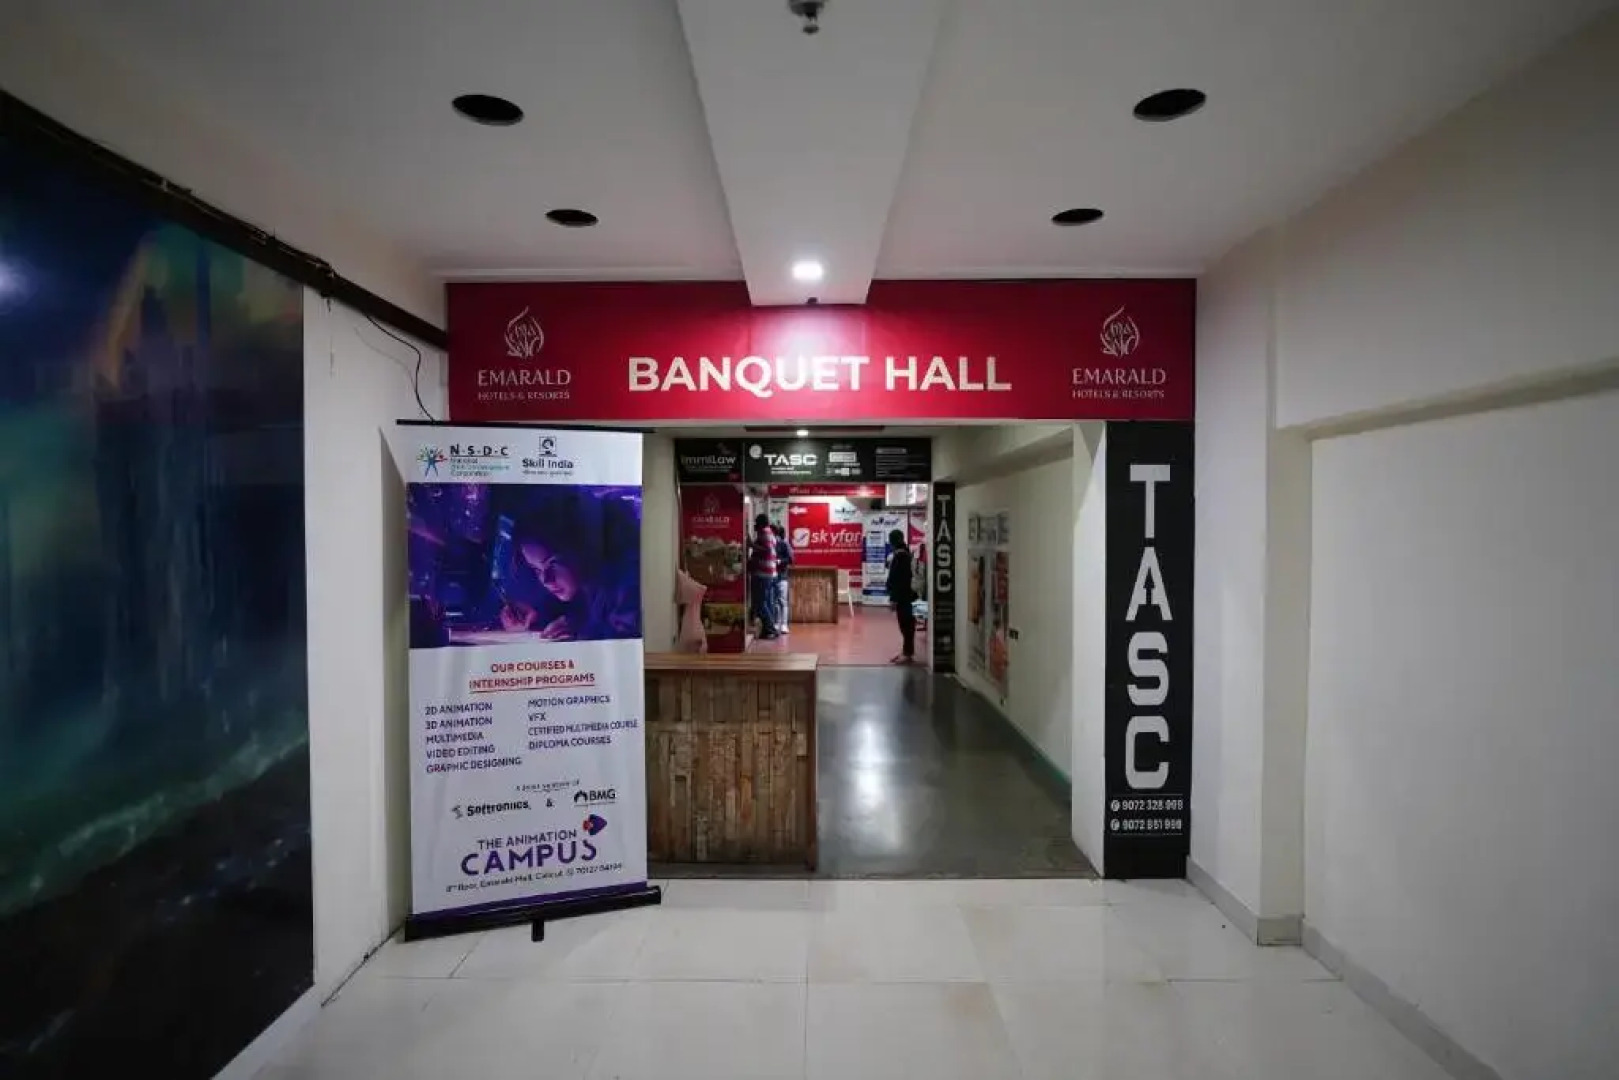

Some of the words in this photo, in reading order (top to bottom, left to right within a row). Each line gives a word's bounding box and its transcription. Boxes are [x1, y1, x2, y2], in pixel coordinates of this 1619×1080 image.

[477, 369, 571, 387] EMARALD
[629, 356, 869, 397] BANQUET
[885, 356, 1012, 391] HALL
[1072, 368, 1166, 385] EMARALD
[478, 391, 514, 401] HOTELS
[527, 390, 570, 400] RESORTS
[1072, 389, 1110, 399] HOTELS
[1121, 389, 1165, 399] RESORTS
[522, 458, 545, 468] Skill
[547, 459, 574, 469] India
[764, 454, 817, 466] TASC
[936, 494, 952, 592] TASC
[1125, 464, 1173, 789] TASC
[490, 663, 515, 673] OUR
[516, 660, 567, 671] COURSES
[469, 676, 534, 688] INTERNSHIP
[535, 673, 595, 684] PROGRAMS
[528, 698, 564, 707] MOTION
[565, 695, 610, 705] GRAPHICS
[425, 706, 438, 715] 2D
[439, 702, 493, 714] ANIMATION
[425, 721, 437, 730] 3D
[439, 717, 493, 728] ANIMATION
[528, 712, 546, 722] VFX
[528, 725, 565, 736] CERTIFIED
[566, 722, 609, 733] MULTIMEDIA
[610, 718, 638, 729] COURSE
[426, 732, 484, 744] MULTIMEDIA
[529, 738, 570, 750] DIPLOMA
[570, 735, 612, 747] COURSES
[426, 748, 456, 759] VIDEO
[457, 745, 496, 757] EDITING
[426, 761, 469, 774] GRAPHIC
[470, 757, 522, 770] DESIGNING
[545, 799, 554, 808] &
[589, 788, 616, 801] BMG
[1122, 799, 1145, 810] 9072
[1122, 818, 1145, 830] 9072
[477, 837, 502, 850] THE
[505, 828, 578, 847] ANIMATION
[460, 839, 597, 876] CAMPUS
